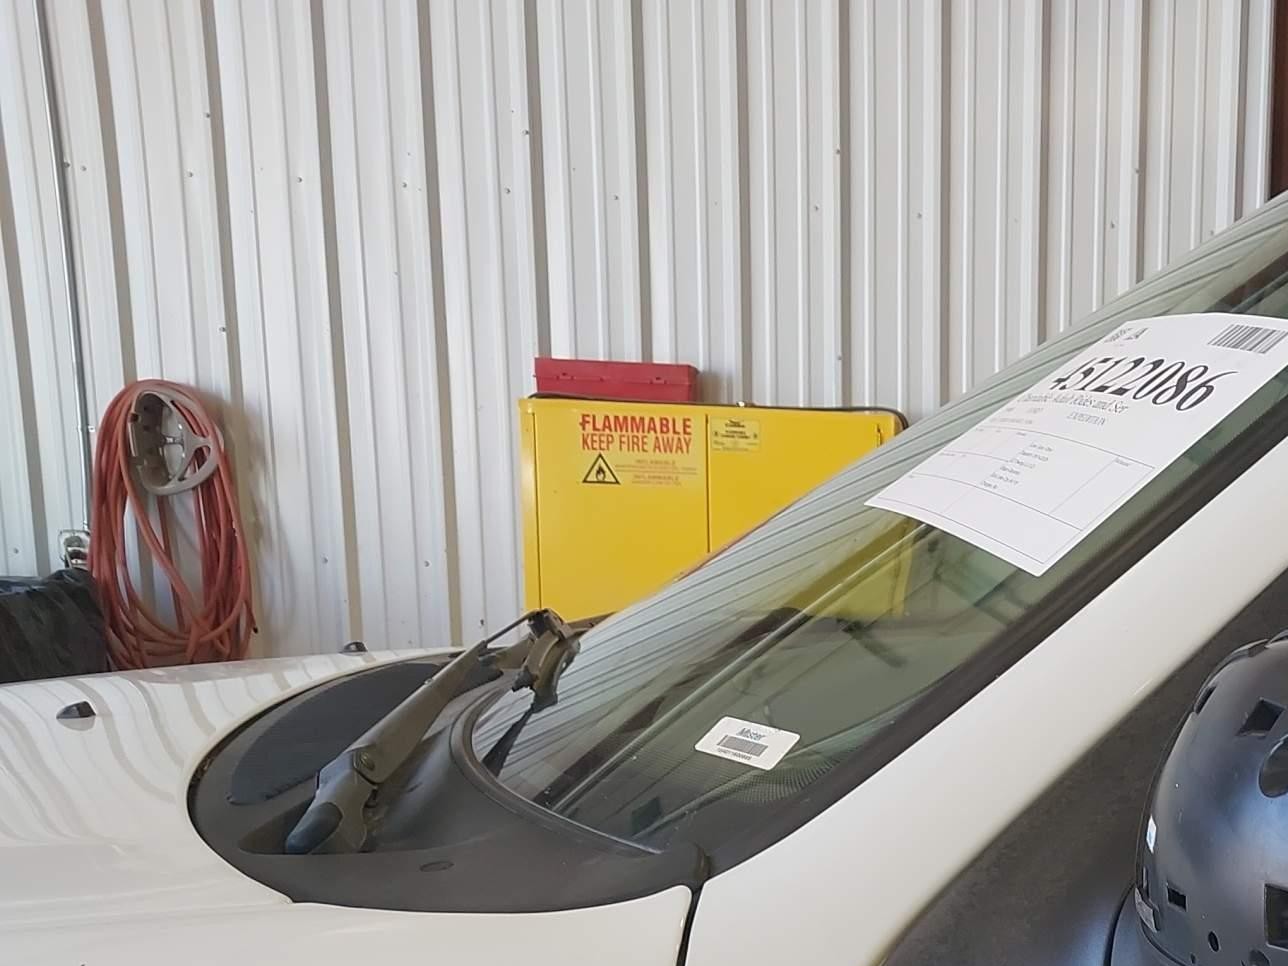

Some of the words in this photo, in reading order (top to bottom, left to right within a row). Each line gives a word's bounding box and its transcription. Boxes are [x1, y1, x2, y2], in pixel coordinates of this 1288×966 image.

[1049, 356, 1239, 411] 45122086
[580, 413, 693, 436] FLAMMABLE
[582, 432, 615, 451] KEEP
[619, 434, 649, 453] FIRE
[653, 435, 693, 454] AWAY
